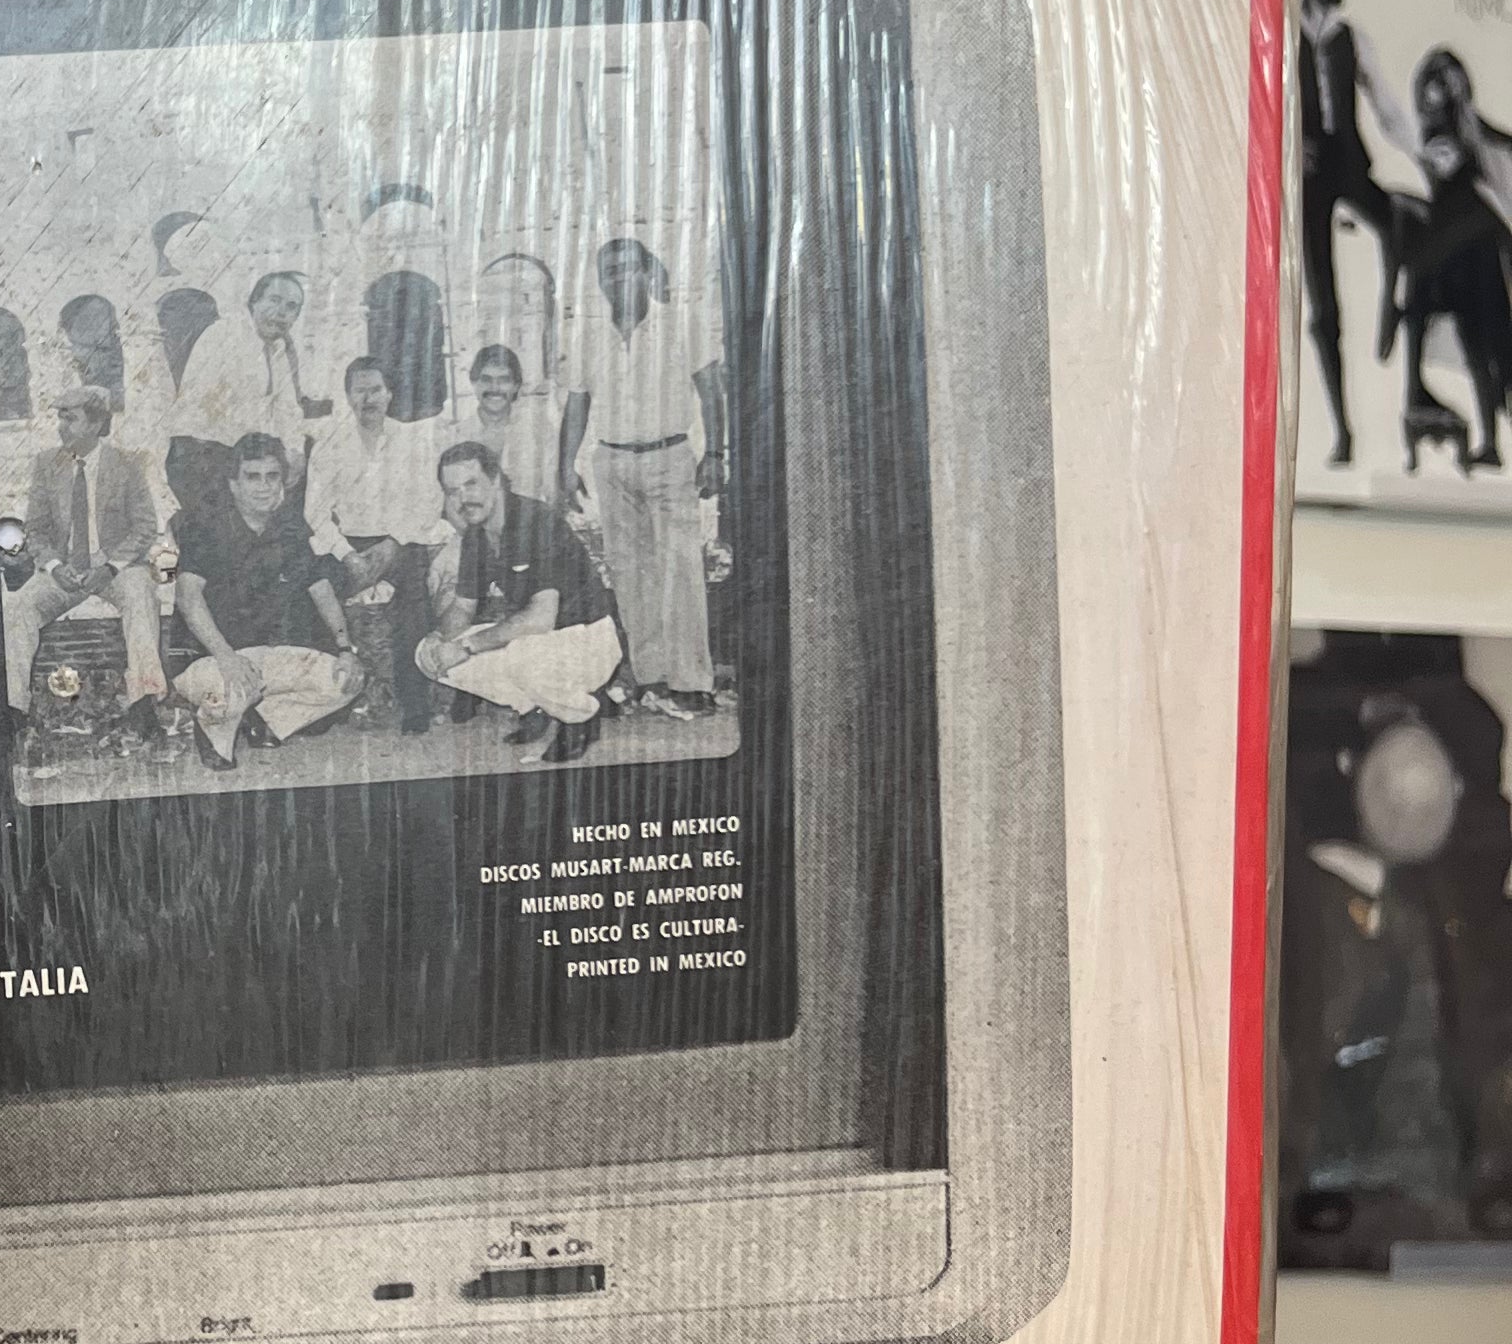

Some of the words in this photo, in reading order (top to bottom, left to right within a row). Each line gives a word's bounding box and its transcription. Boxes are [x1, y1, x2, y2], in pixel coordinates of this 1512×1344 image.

[572, 824, 630, 843] HECHO
[641, 821, 662, 838] EN
[672, 816, 740, 836] MEXICO
[480, 863, 541, 883] DISCOS
[551, 853, 692, 878] MUSART-MARCA
[703, 850, 741, 867] REG.
[521, 893, 604, 914] MIEMBRO
[614, 890, 635, 907] DE
[646, 883, 742, 905] AMPROFON
[537, 930, 561, 946] -EL
[571, 925, 622, 944] DISCO
[632, 923, 650, 940] ES
[660, 917, 744, 938] CULTURA-
[567, 958, 640, 978] PRINTED
[650, 956, 668, 972] IN
[679, 950, 746, 970] MEXICO
